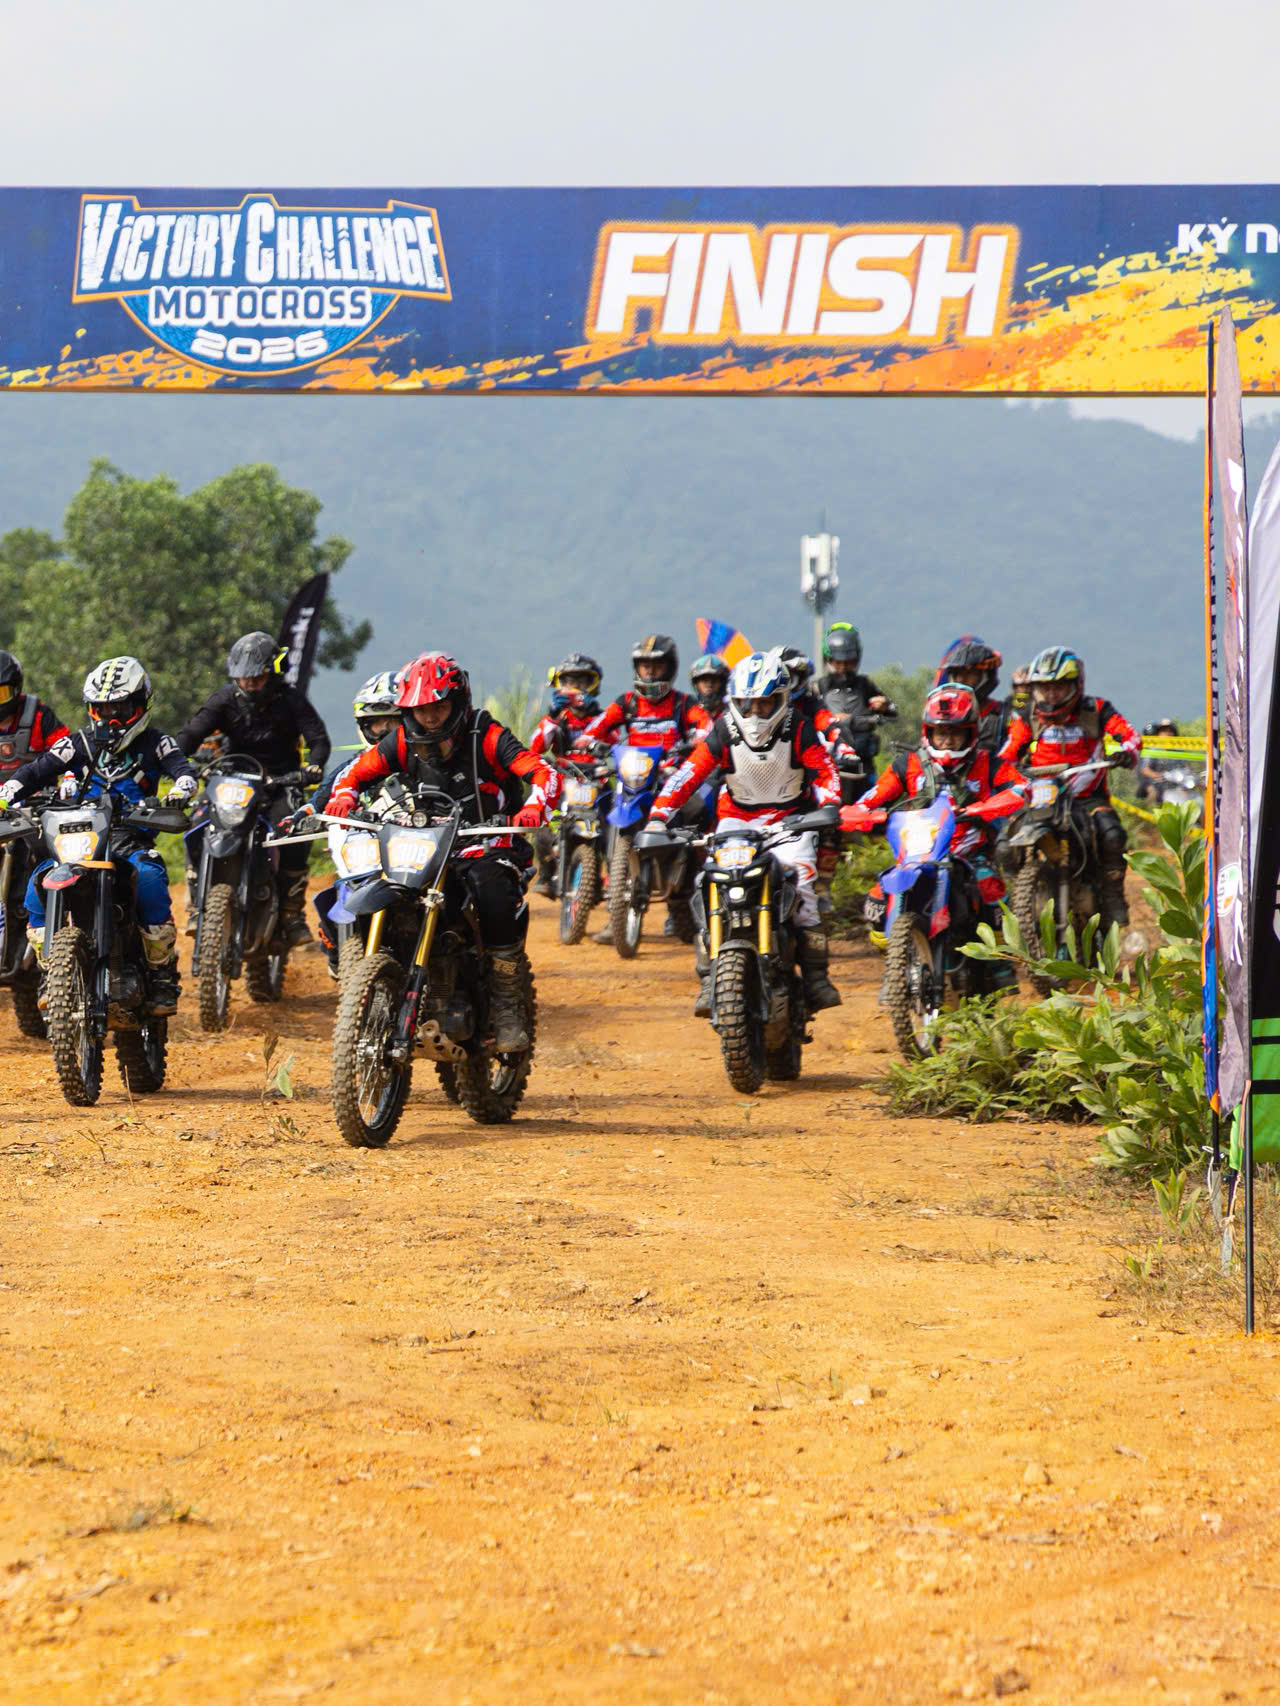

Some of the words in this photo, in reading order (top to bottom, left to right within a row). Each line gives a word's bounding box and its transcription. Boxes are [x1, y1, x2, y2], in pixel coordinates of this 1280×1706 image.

[245, 202, 445, 290] CHALLENGE
[153, 288, 367, 320] MOTOCROSS
[595, 231, 1009, 337] FINISH
[190, 328, 329, 363] 2026
